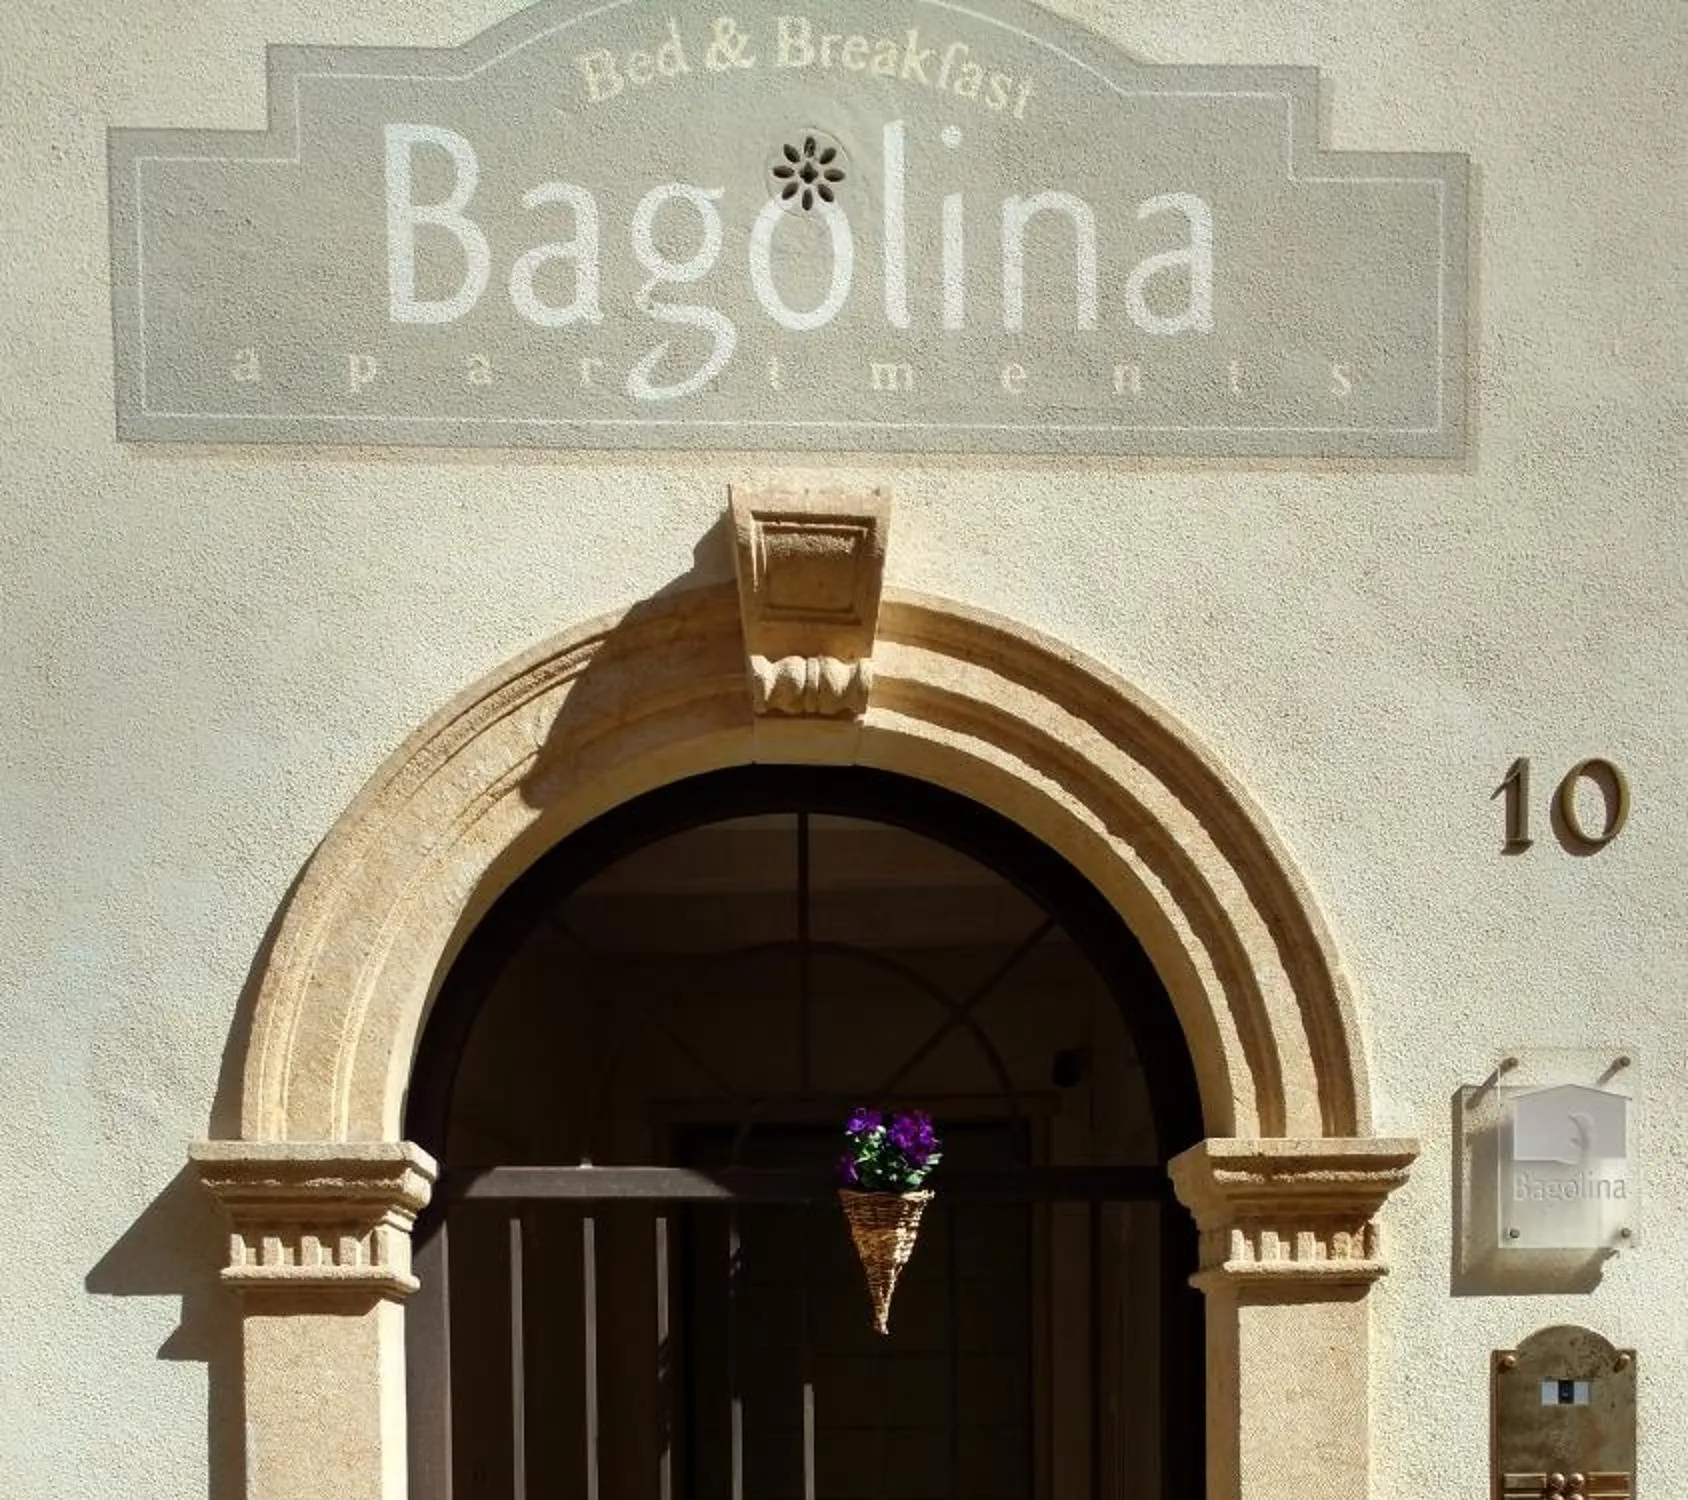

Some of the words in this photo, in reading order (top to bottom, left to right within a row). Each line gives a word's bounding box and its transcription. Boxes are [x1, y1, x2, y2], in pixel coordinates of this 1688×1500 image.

[578, 16, 692, 102] Bed
[704, 16, 757, 72] &
[776, 14, 1036, 119] Breakfast
[383, 117, 1215, 402] Bagolina
[1490, 757, 1631, 857] 10
